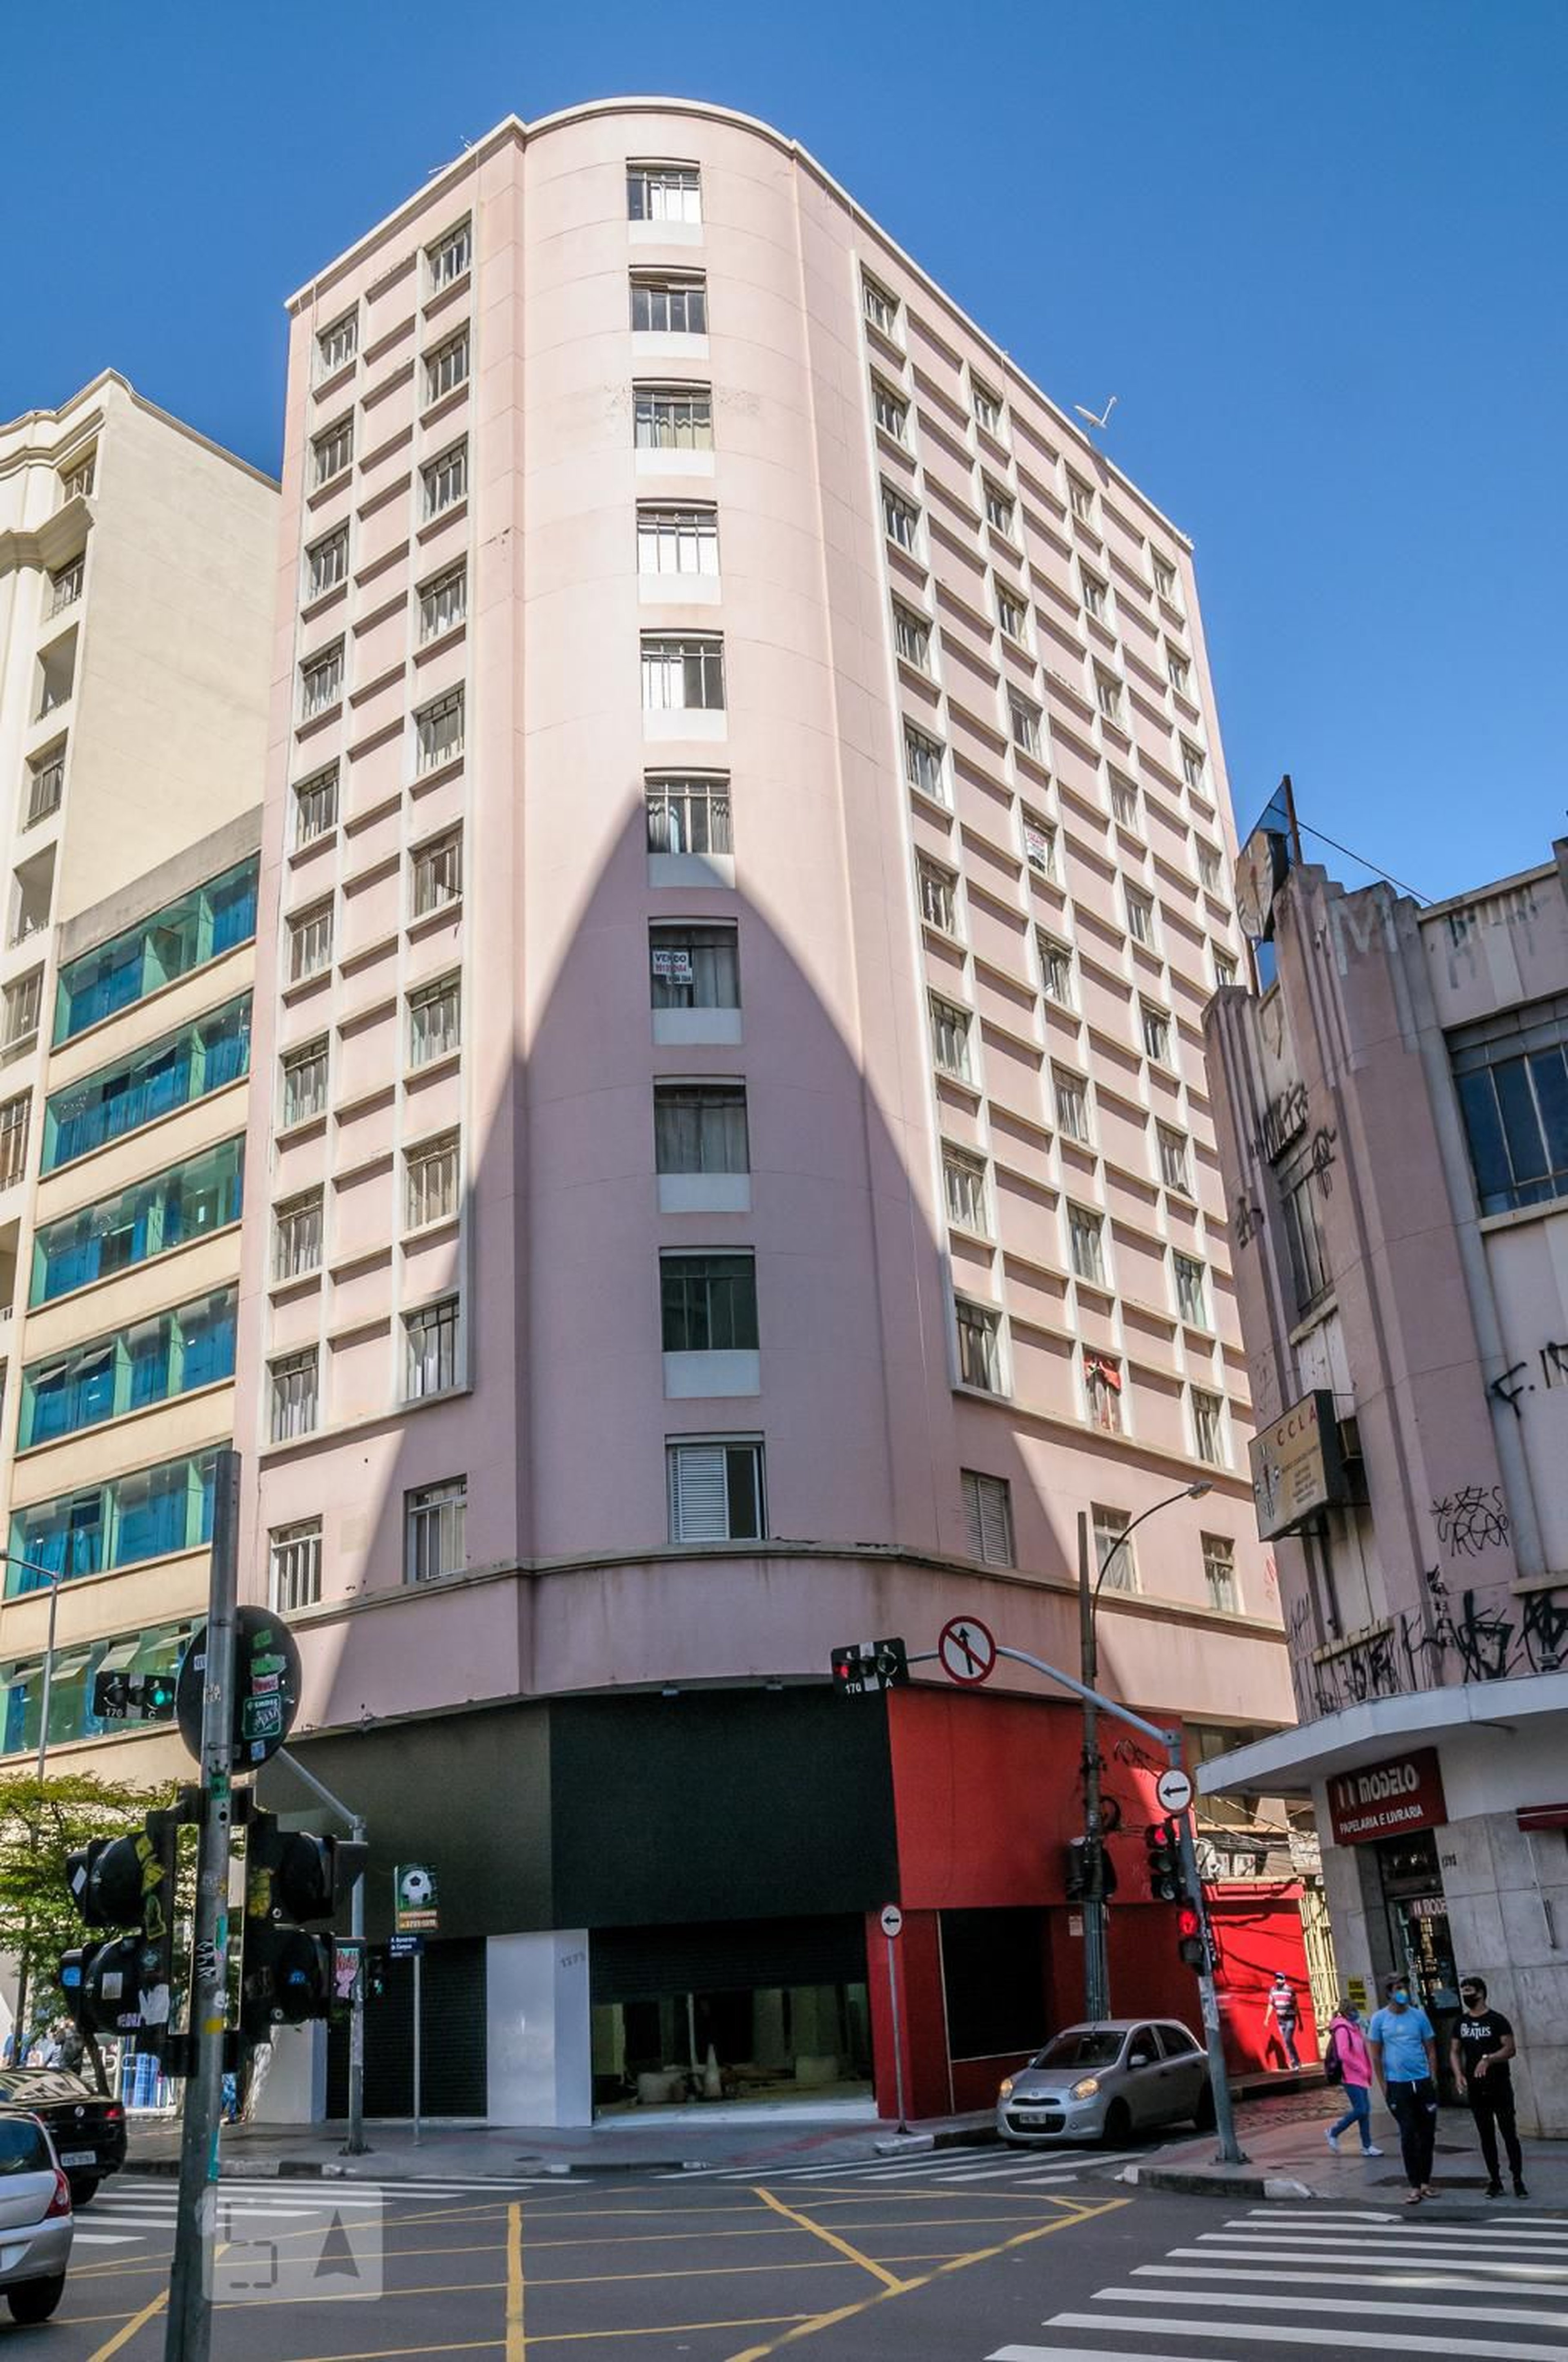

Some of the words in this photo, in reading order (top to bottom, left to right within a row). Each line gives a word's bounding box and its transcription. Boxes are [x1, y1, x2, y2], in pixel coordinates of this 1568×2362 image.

[1276, 1404, 1318, 1446] CCLA
[845, 1682, 862, 1694] 170
[885, 1677, 893, 1688] A
[106, 1708, 123, 1718] 170
[148, 1711, 156, 1720] C
[1358, 1764, 1418, 1804] MODELO
[1340, 1816, 1379, 1835] PAPELARIA
[1379, 1813, 1386, 1825] E
[1386, 1804, 1424, 1824] LIVRARIA
[1461, 2023, 1491, 2040] BEATLES
